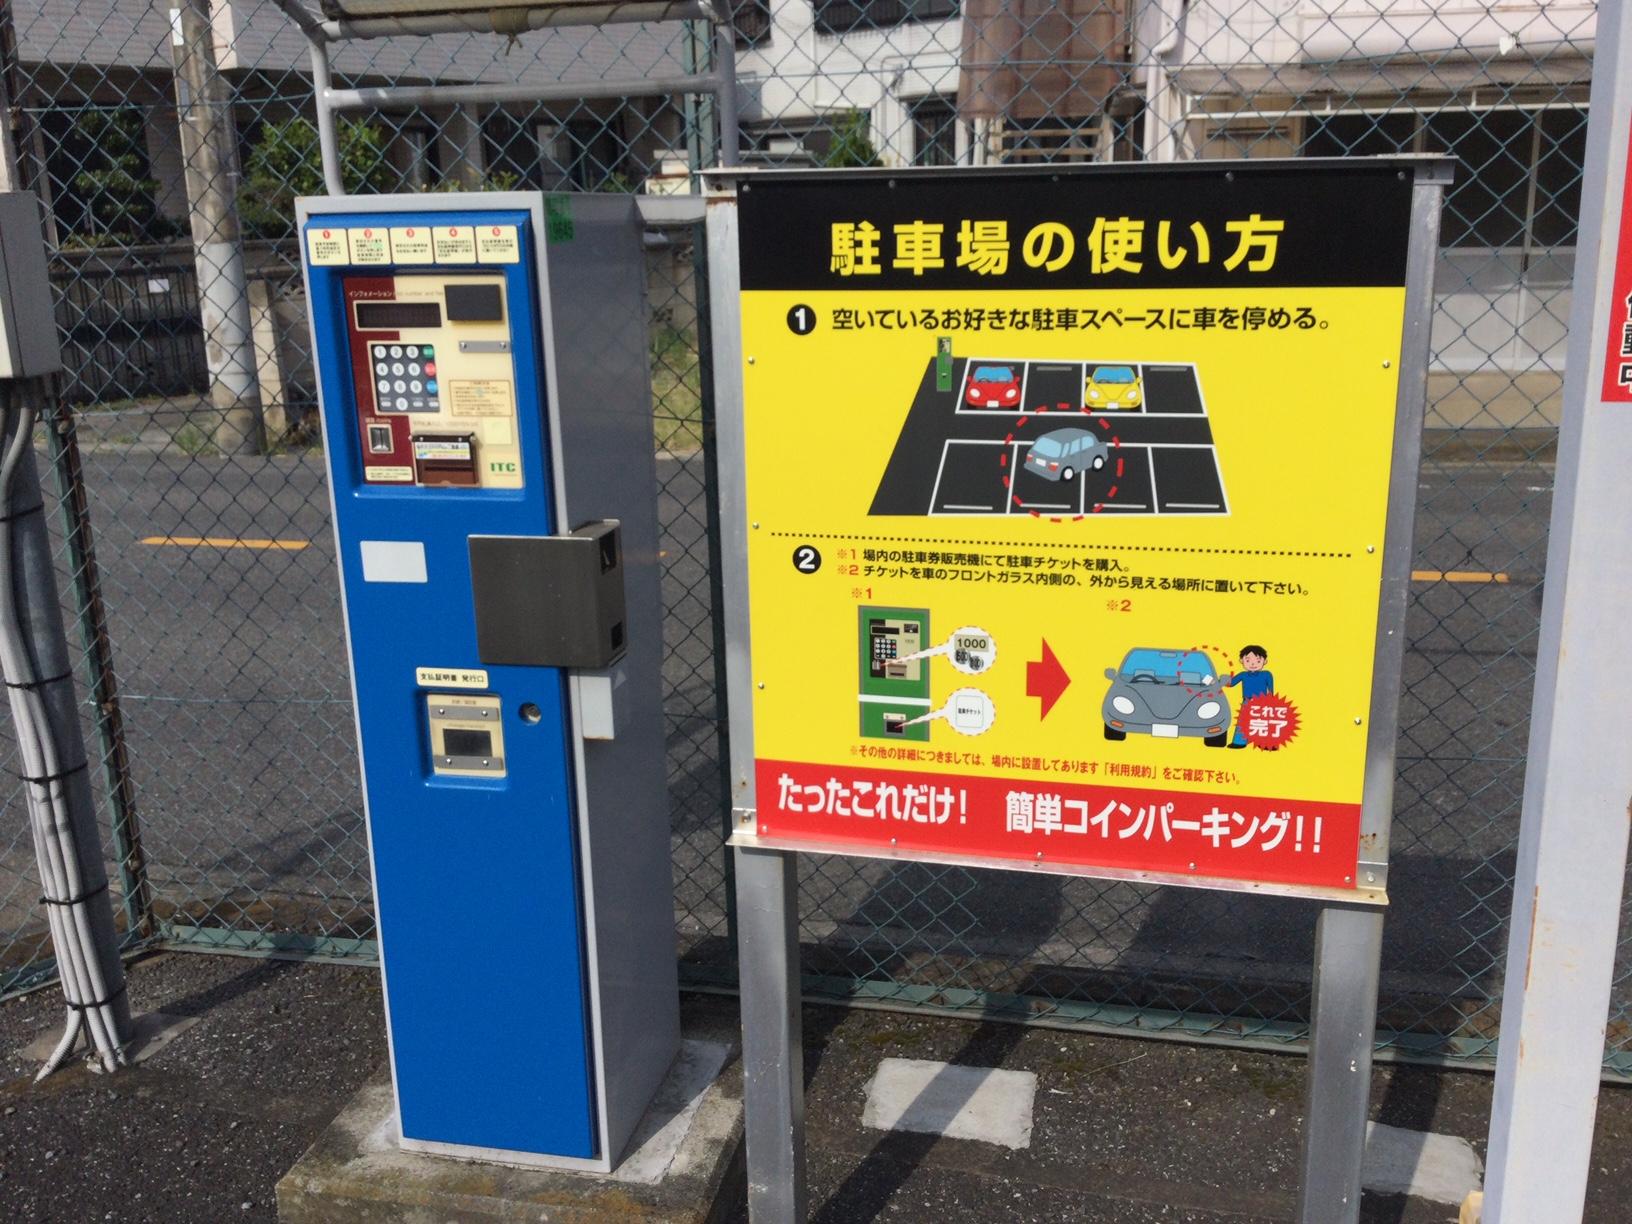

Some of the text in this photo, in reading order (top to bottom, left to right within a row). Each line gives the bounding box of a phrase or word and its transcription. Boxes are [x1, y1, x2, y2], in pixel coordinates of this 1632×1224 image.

[831, 215, 1284, 275] 駐車場の使い方
[832, 306, 1329, 332] 空いているお好きな駐車スペースに車を停める。
[490, 462, 516, 472] ITC
[863, 549, 1129, 572] 場内の駐車券販売機にて駐車チケットを購入。
[864, 565, 1308, 596] チケットを車のフロントガラス内側の、外から見える場所に置いて下さい。
[958, 638, 986, 648] 1000
[1249, 705, 1288, 719] これで
[1248, 719, 1288, 738] 完了
[850, 745, 1240, 784] ※その他の詳細につきましては、場内に設置してあります「利用規約」をご確認下さい。
